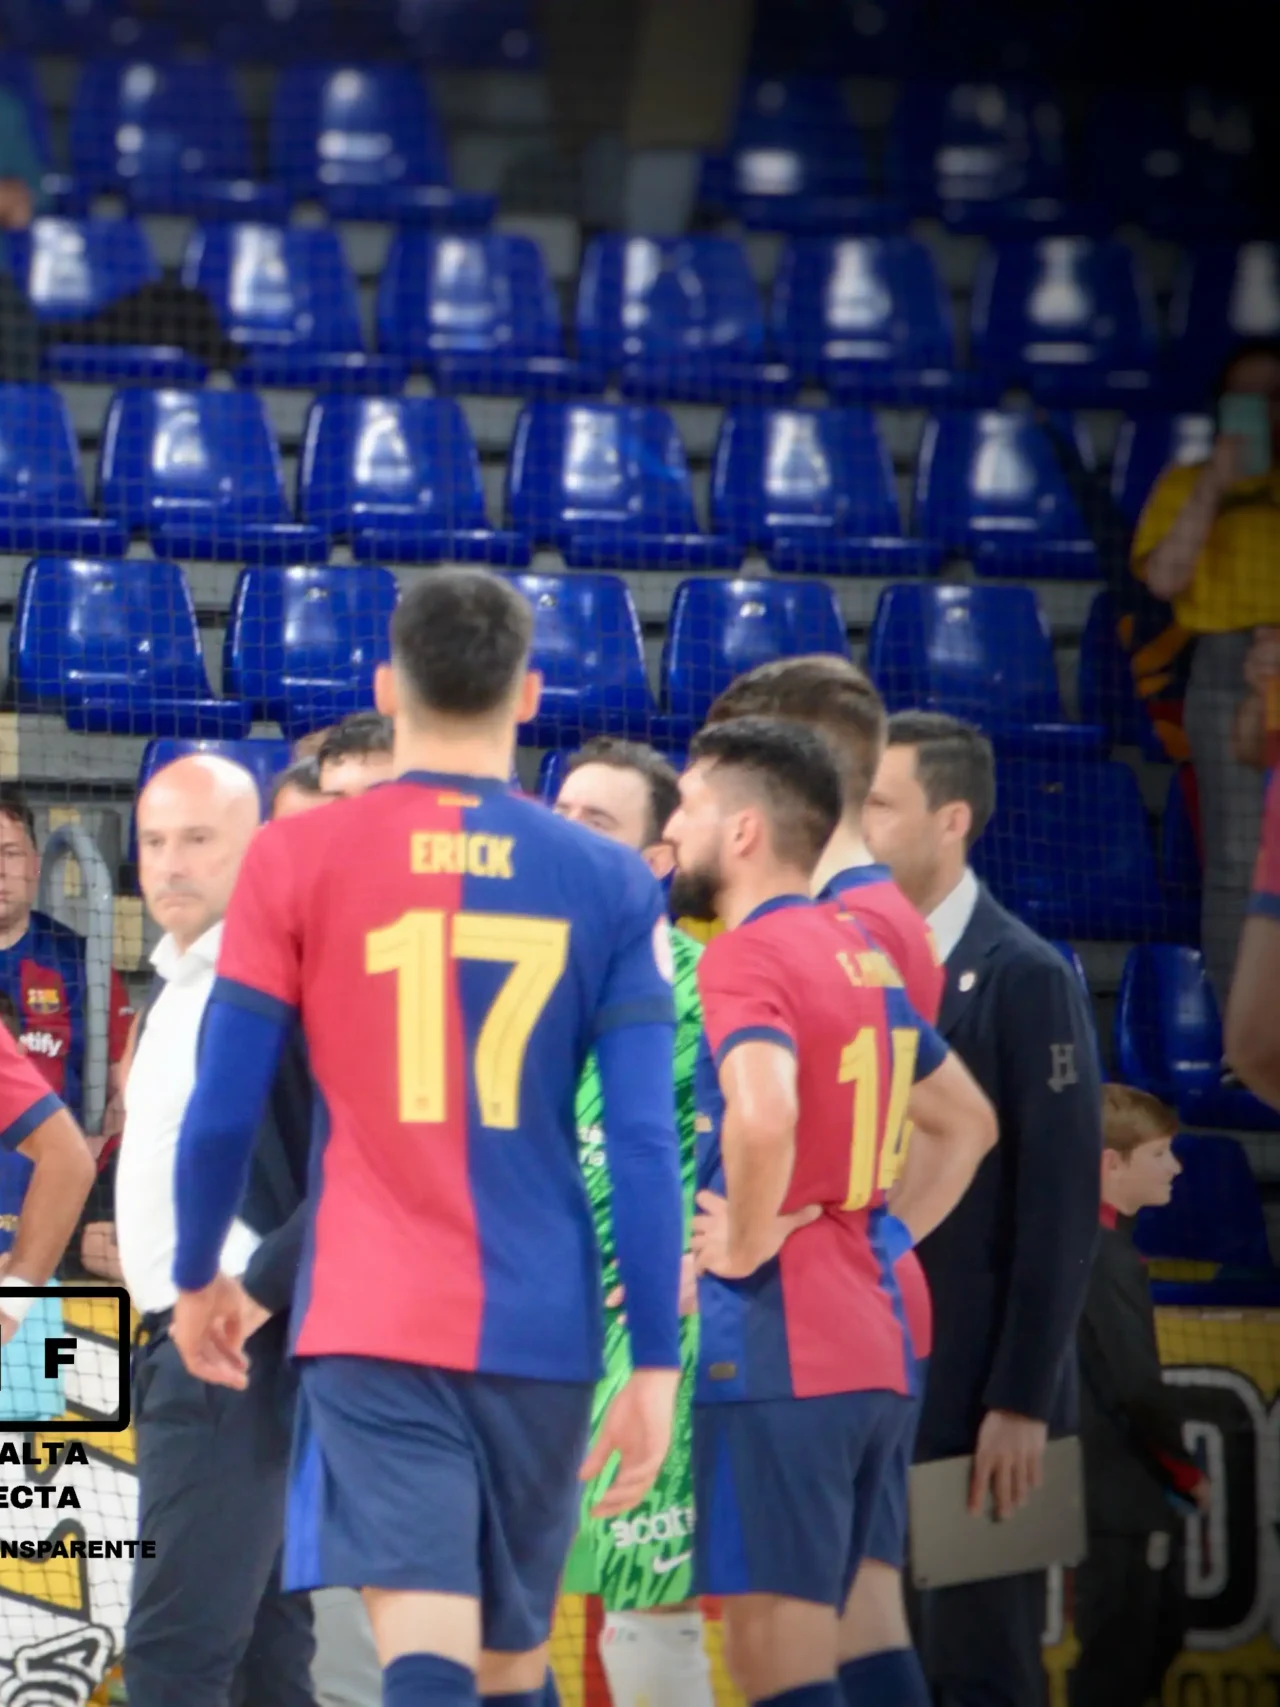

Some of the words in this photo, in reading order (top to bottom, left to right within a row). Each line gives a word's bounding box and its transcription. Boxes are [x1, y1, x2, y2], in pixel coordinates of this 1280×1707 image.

[409, 831, 515, 879] ERICK
[364, 908, 570, 1130] 17
[19, 1030, 63, 1058] tify
